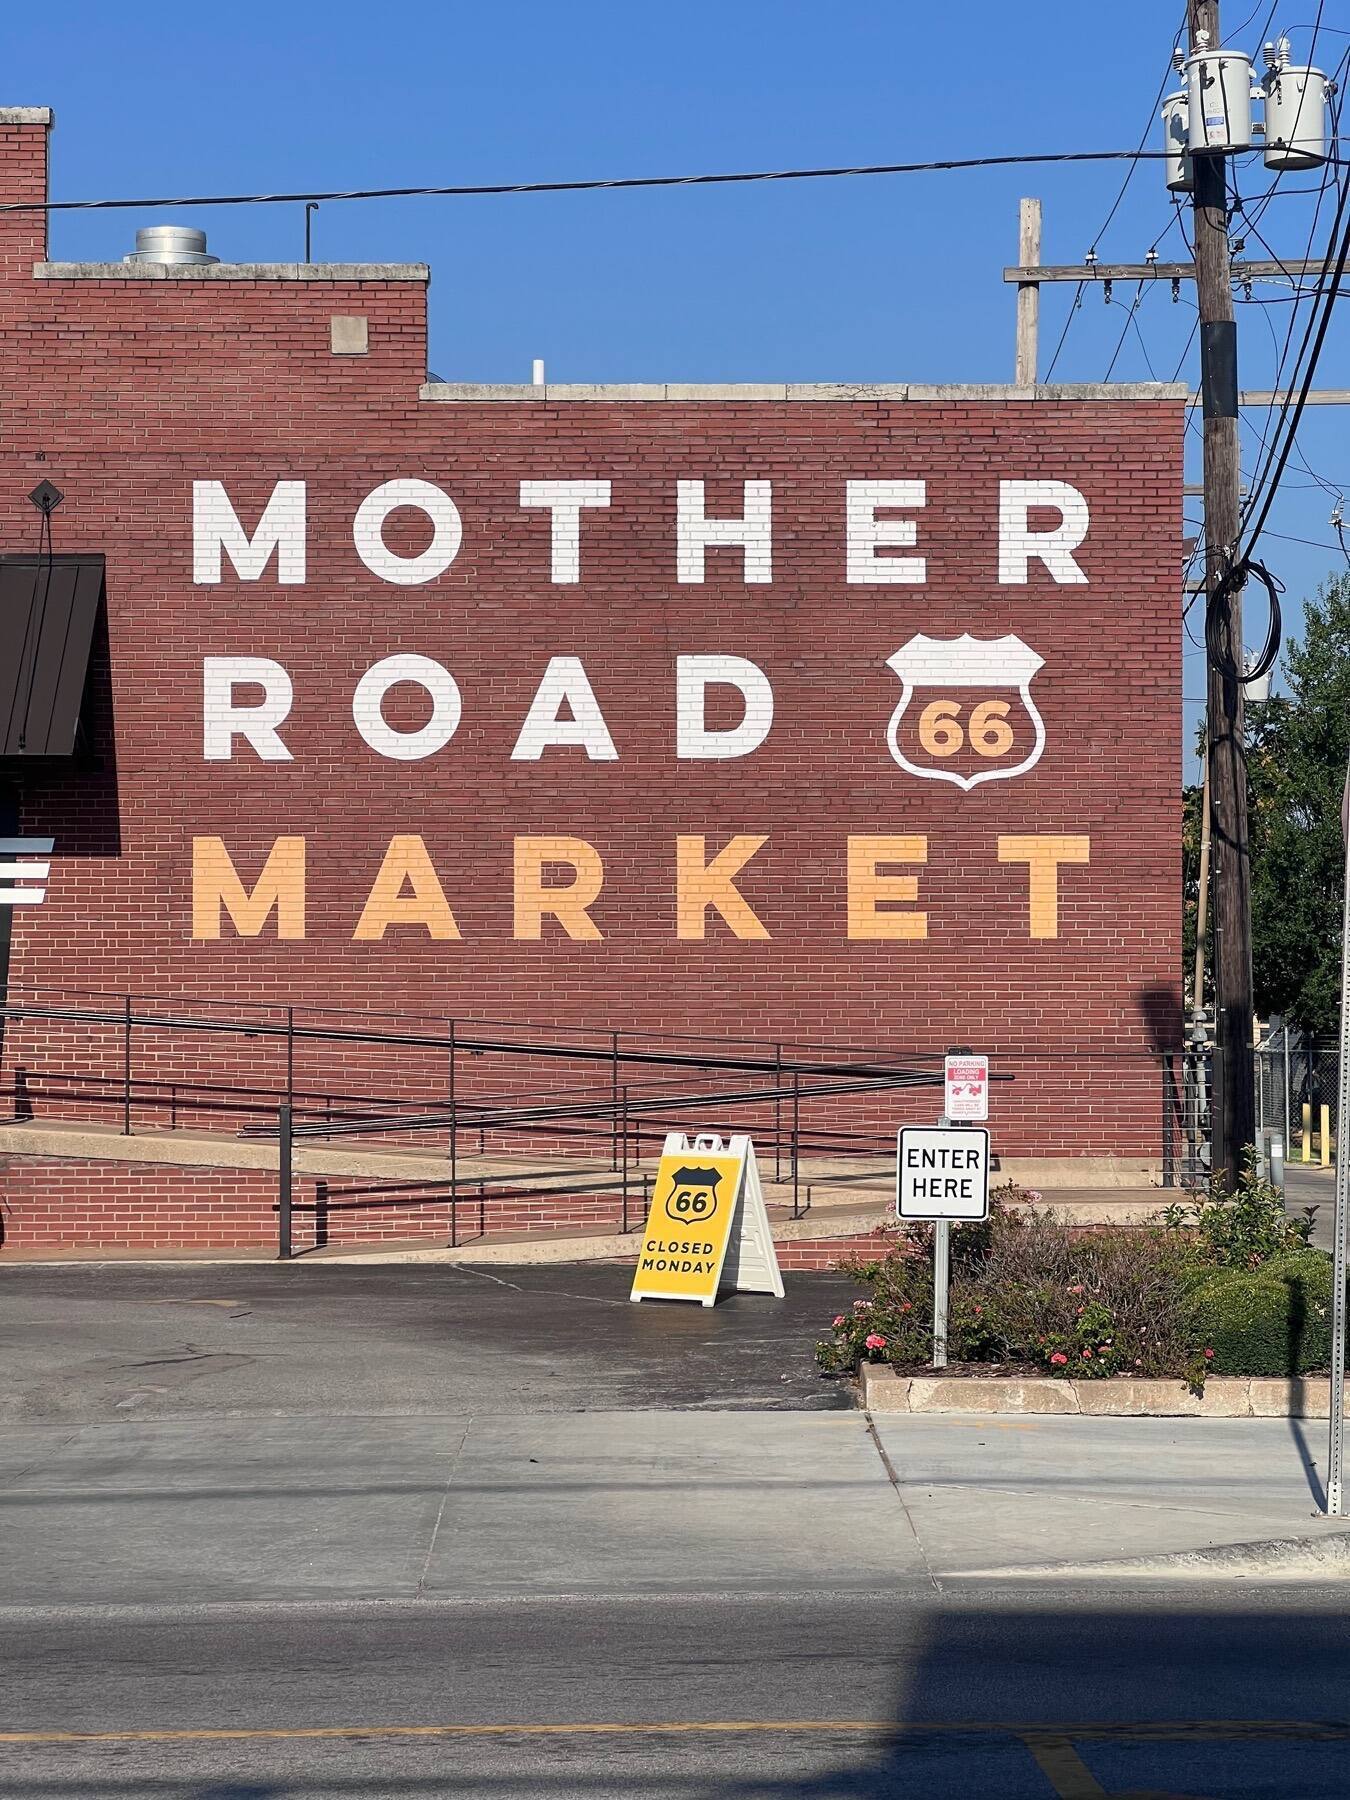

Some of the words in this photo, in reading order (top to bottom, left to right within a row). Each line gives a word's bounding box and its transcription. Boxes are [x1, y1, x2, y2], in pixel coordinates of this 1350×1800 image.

[192, 477, 1090, 585] MOTHER
[203, 653, 774, 761] ROAD
[919, 699, 1014, 757] 66
[192, 834, 1090, 940] MARKET
[907, 1148, 980, 1169] ENTER
[913, 1178, 973, 1198] HERE
[675, 1191, 708, 1213] 66
[646, 1240, 714, 1255] CLOSED
[641, 1259, 716, 1274] MONDAY
